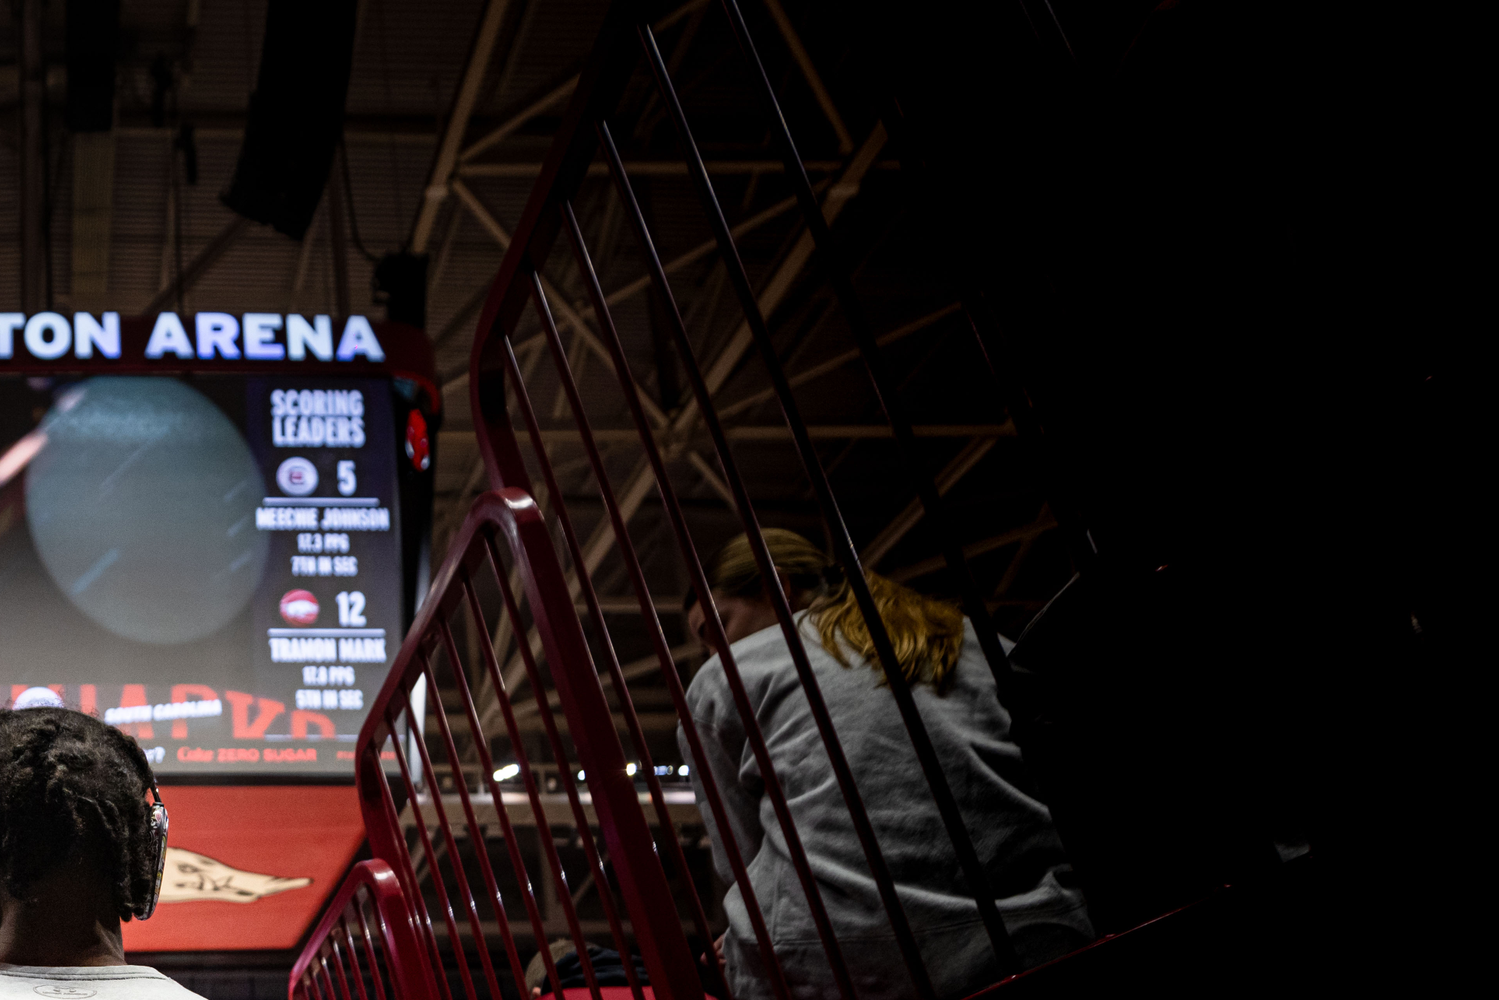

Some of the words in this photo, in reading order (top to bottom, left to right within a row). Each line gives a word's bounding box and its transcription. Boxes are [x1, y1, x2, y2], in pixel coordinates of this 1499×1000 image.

[144, 313, 385, 362] ARENA
[271, 389, 364, 416] SCORING
[273, 416, 366, 447] LEADERS
[337, 460, 357, 495] 5
[333, 556, 358, 577] SEC
[336, 591, 367, 627] 12
[339, 638, 387, 662] MARK
[177, 746, 214, 763] Coke
[217, 748, 260, 763] ZERO
[263, 748, 317, 762] SUGAR
